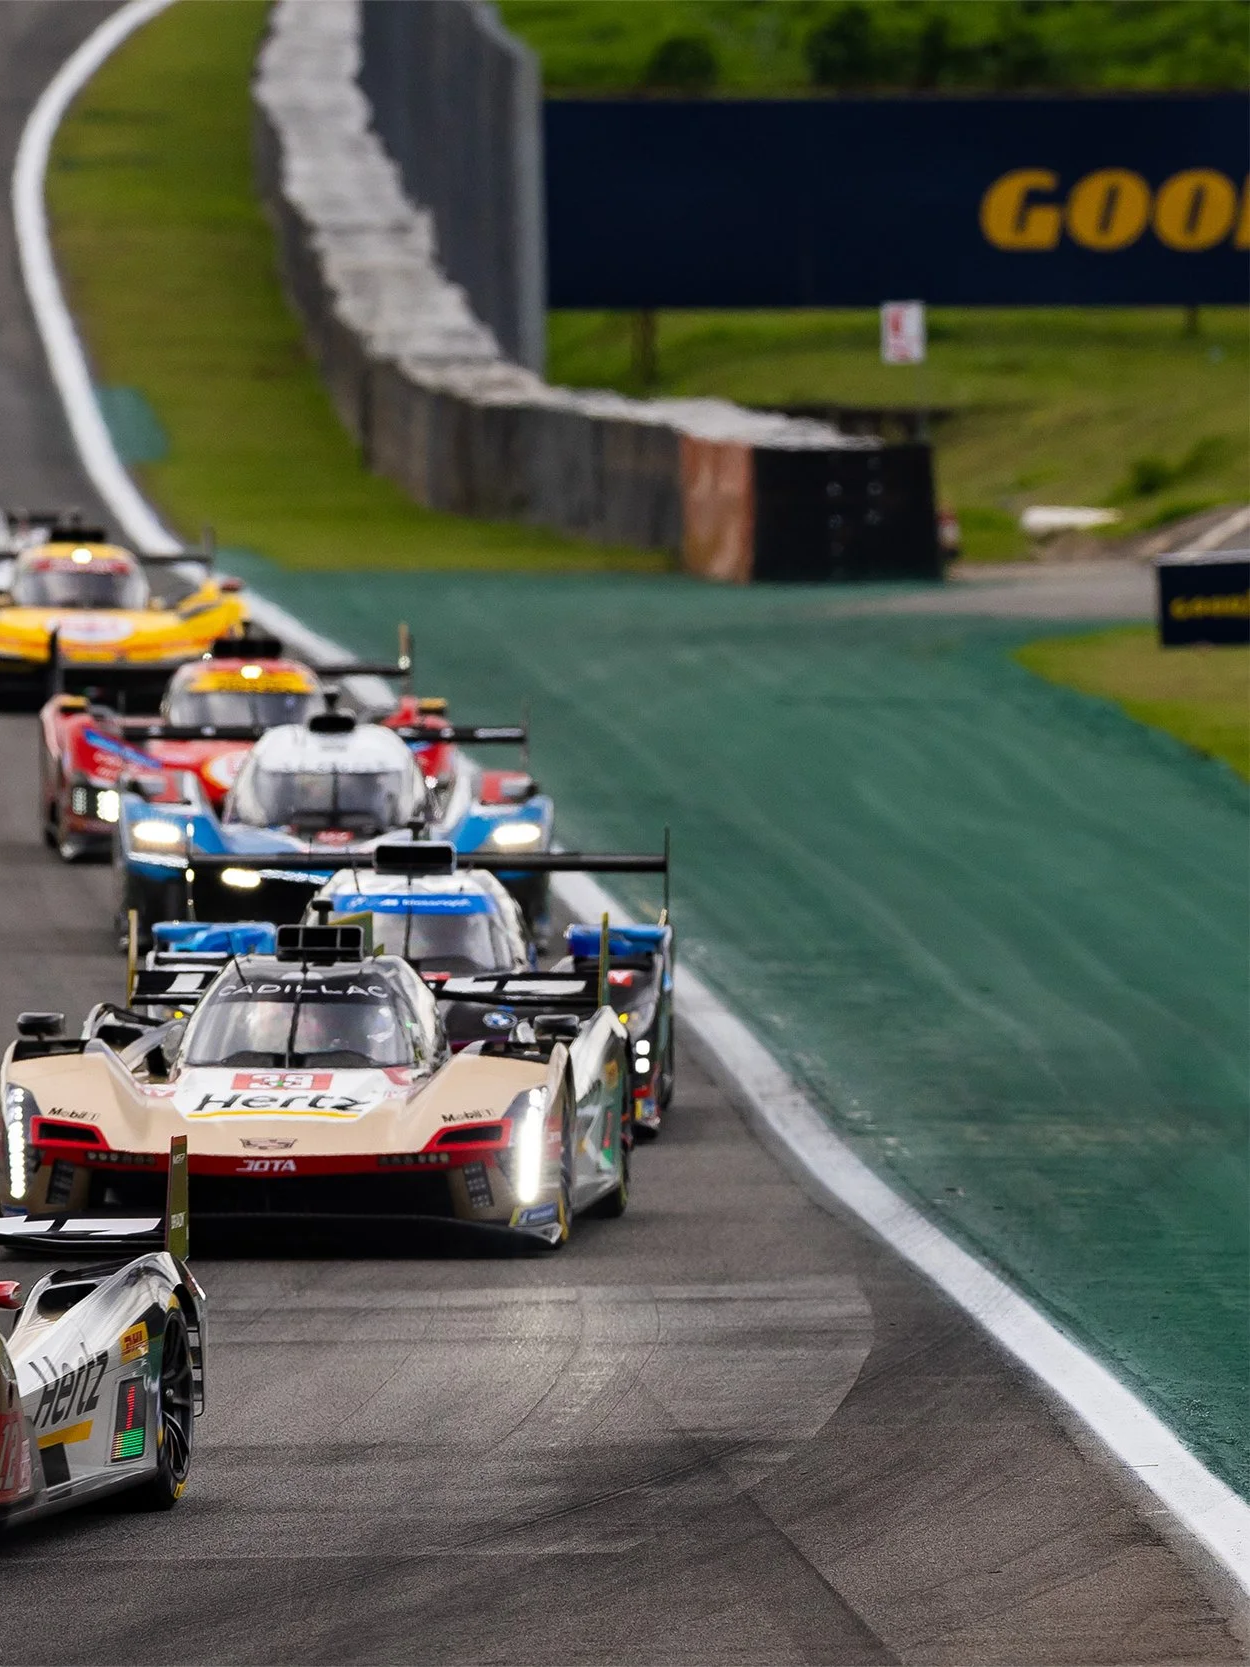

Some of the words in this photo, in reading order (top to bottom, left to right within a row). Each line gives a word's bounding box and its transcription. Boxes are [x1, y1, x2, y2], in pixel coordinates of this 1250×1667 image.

[979, 167, 1250, 252] GOO
[218, 984, 388, 999] CADILLAC
[193, 1093, 371, 1112] Hertz
[48, 1107, 88, 1120] Mobil
[235, 1159, 296, 1172] JOTA
[28, 1341, 109, 1429] Hertz
